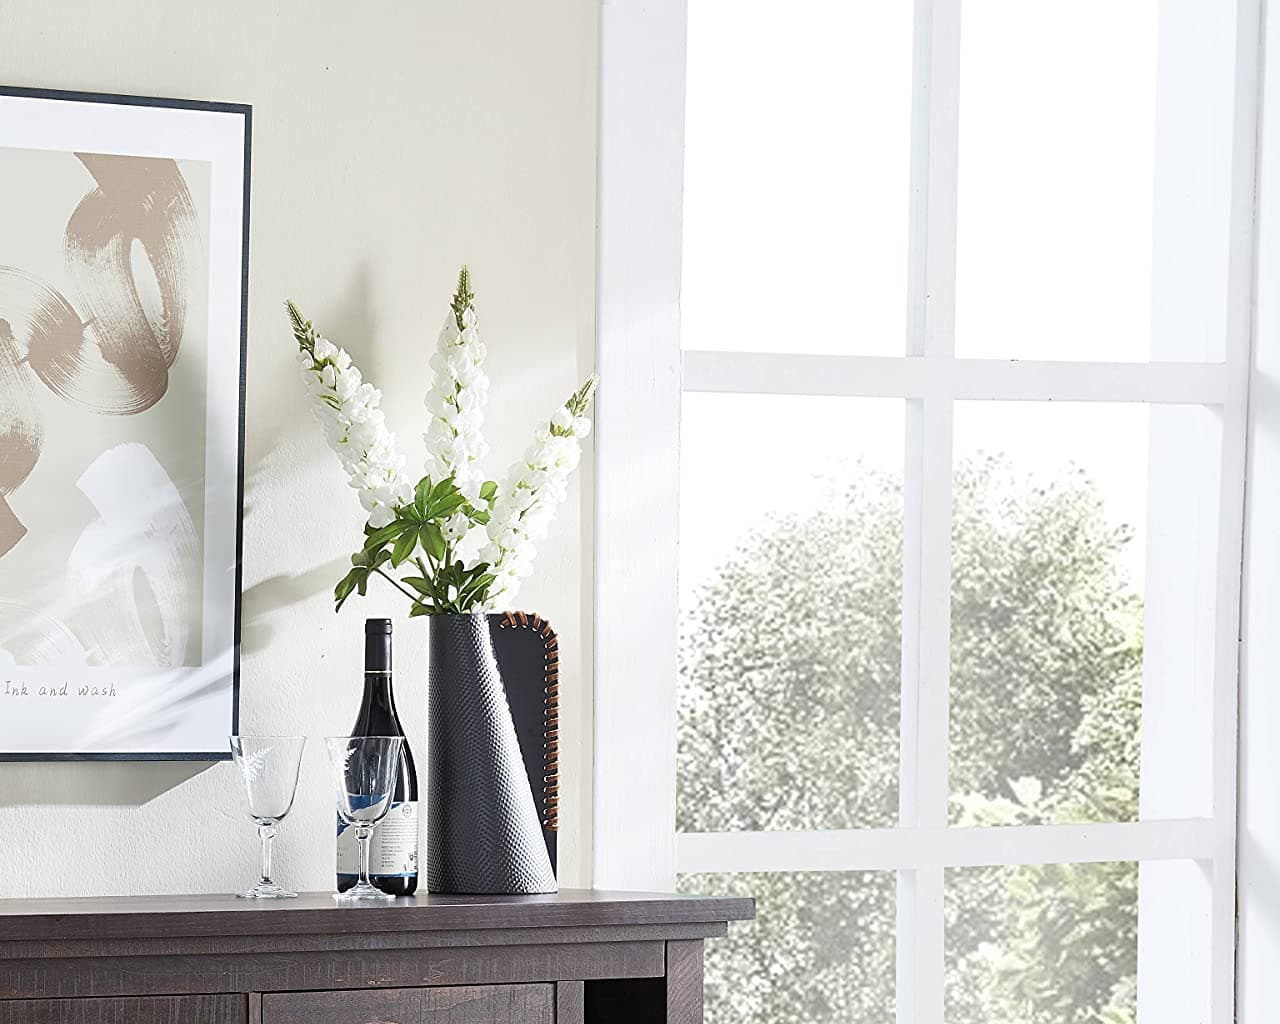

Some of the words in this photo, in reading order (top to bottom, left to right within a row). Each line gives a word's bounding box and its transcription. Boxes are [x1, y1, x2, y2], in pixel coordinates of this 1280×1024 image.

[5, 680, 29, 696] Ink
[38, 681, 68, 697] and
[77, 682, 117, 697] wash
